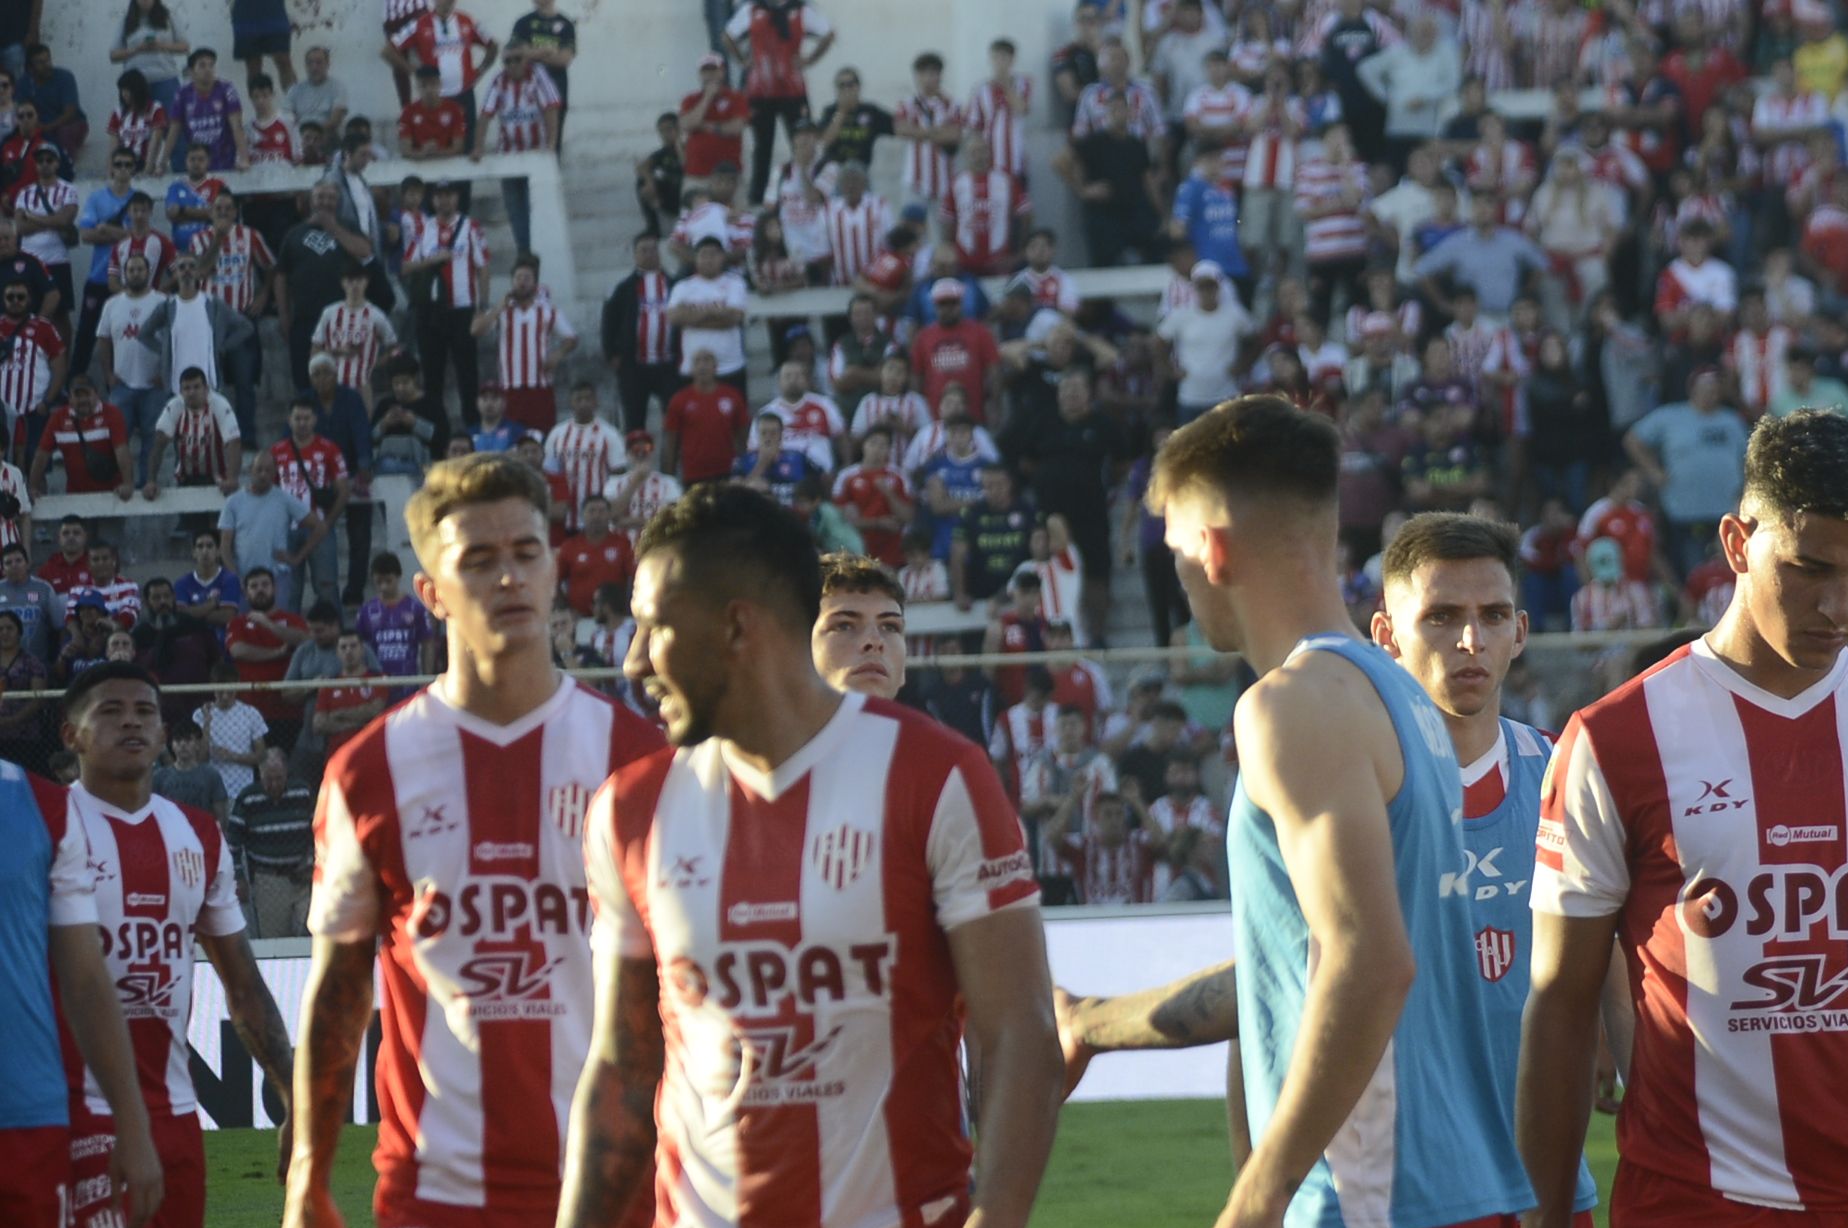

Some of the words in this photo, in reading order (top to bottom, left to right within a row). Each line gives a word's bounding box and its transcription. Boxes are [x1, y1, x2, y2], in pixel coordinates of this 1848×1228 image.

[1684, 799, 1749, 817] KDY
[1792, 829, 1832, 840] Mutual
[1728, 1013, 1817, 1033] SERVICIOS
